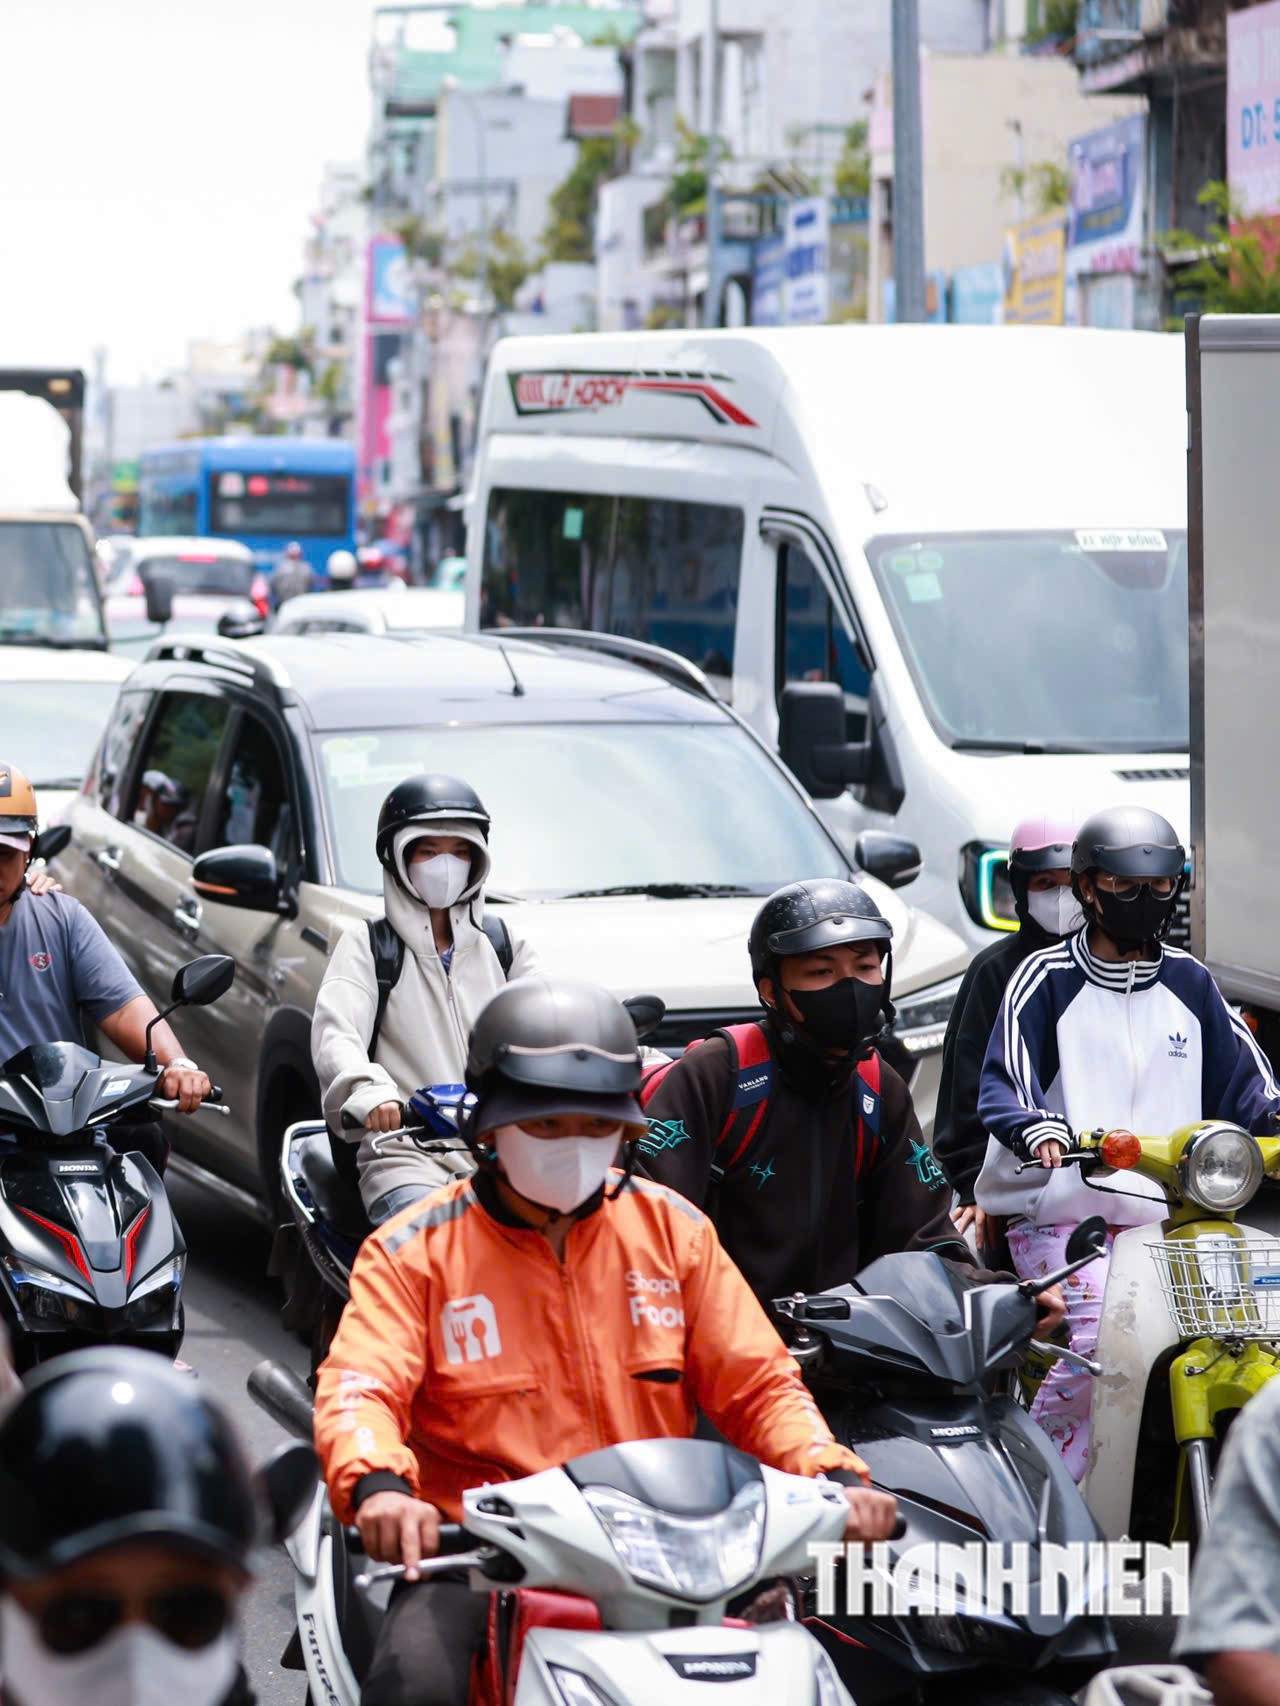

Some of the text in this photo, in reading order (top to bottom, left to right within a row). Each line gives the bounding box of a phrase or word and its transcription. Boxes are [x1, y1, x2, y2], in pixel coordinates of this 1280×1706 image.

[1168, 1050, 1188, 1059] adidas
[738, 1075, 769, 1089] VANLANG
[59, 1164, 99, 1173] HONDA
[929, 1425, 982, 1438] HONDA
[683, 1661, 753, 1675] HONDA
